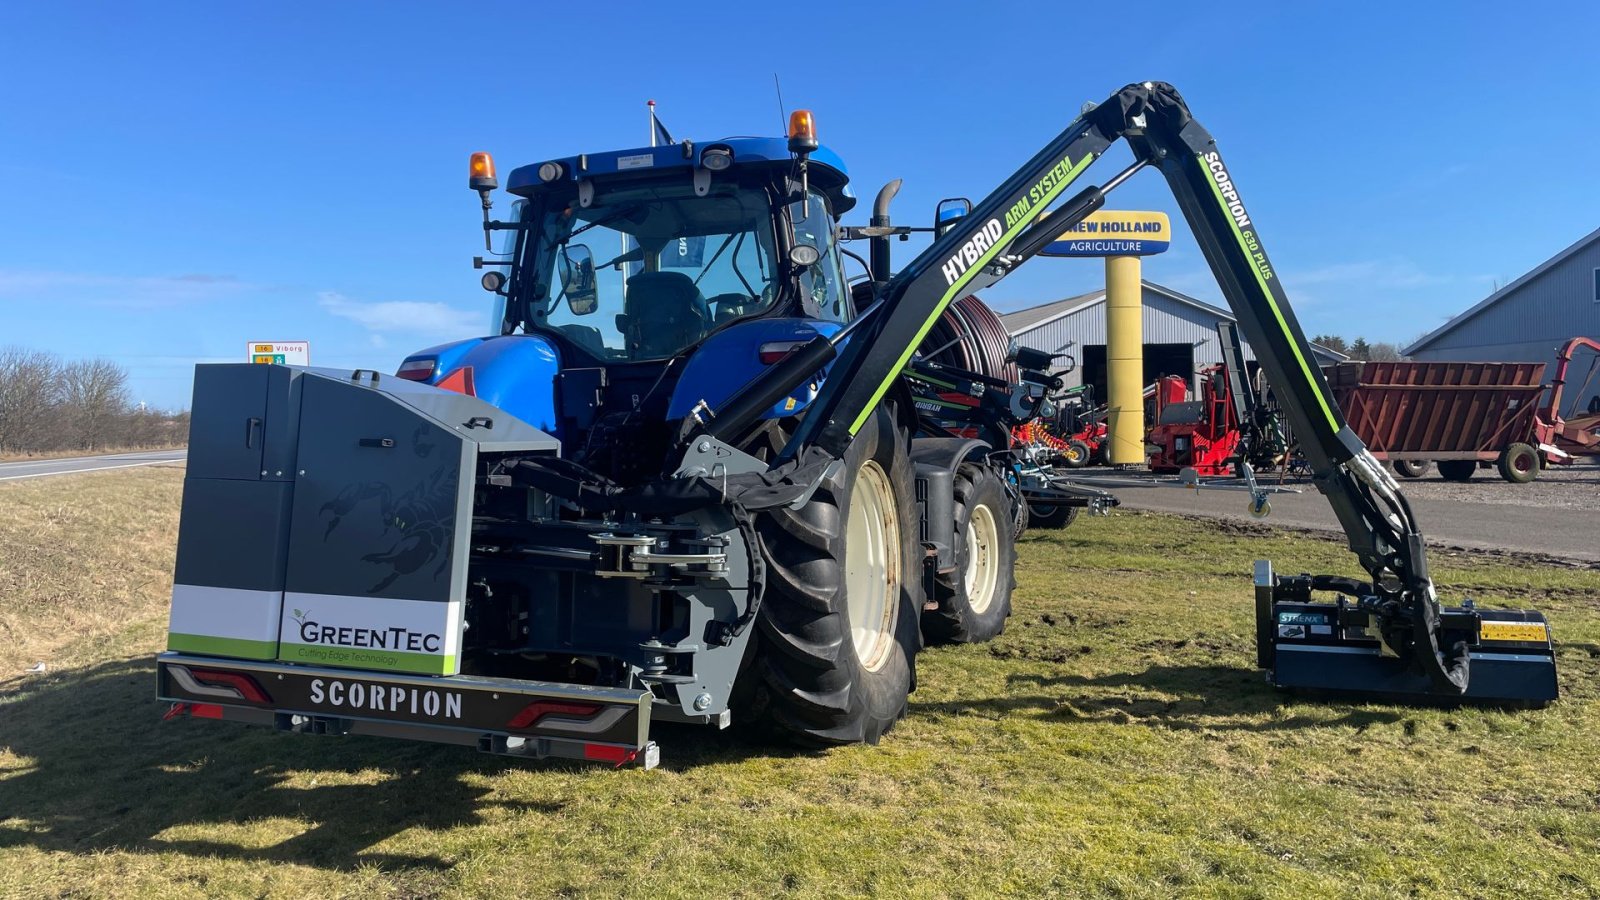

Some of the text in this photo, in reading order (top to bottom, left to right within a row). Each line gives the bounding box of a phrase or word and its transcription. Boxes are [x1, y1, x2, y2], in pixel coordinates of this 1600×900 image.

[941, 155, 1073, 286] HYBRID ARM SYSTEM
[1204, 151, 1273, 280] SCORPION 630 PLUS
[1101, 222, 1162, 233] HOLLAND
[1069, 241, 1141, 251] AGRICULTURE
[915, 401, 942, 412] HYBRID
[1281, 614, 1318, 623] STRENX
[298, 648, 398, 666] Cutting Edge Technology
[310, 679, 462, 719] SCORPION
